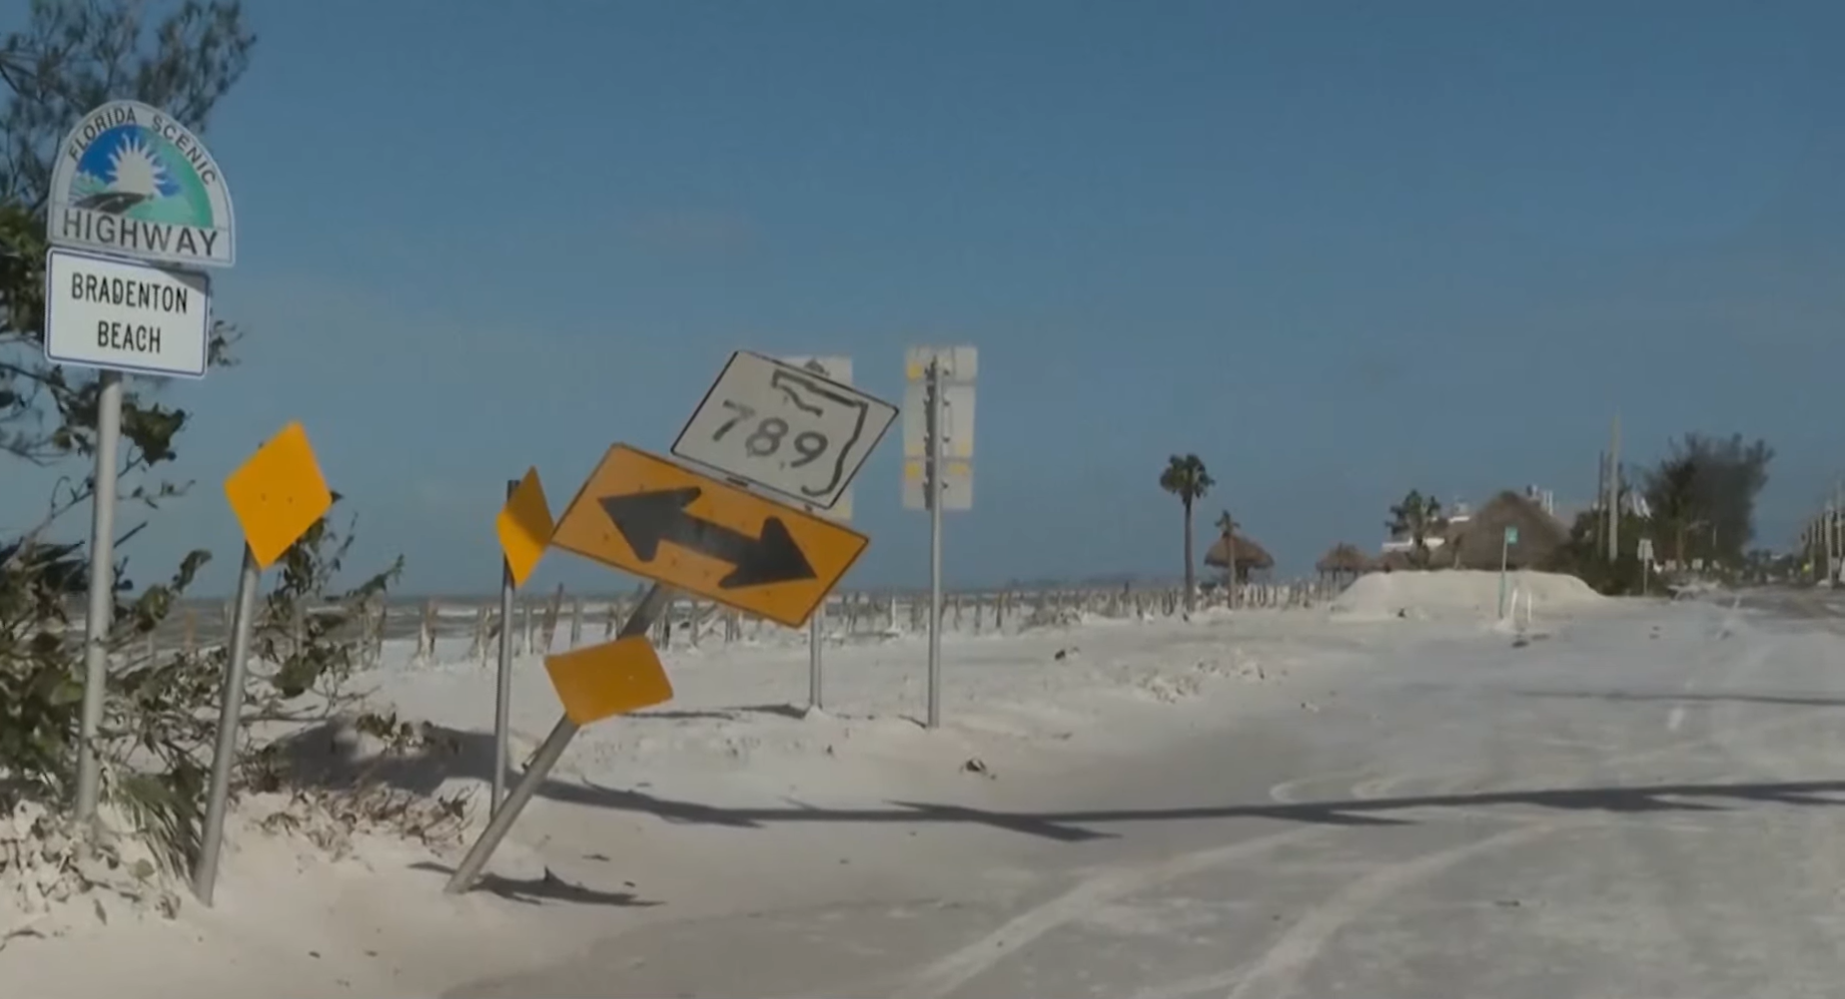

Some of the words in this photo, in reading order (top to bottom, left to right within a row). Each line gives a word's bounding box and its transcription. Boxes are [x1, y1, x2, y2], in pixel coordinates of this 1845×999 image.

[68, 106, 137, 162] FLORIDA
[151, 115, 217, 185] SCENIC
[63, 208, 218, 256] HIGHWAY
[71, 272, 188, 314] BRADENTON
[97, 320, 161, 354] BEACH
[712, 400, 828, 469] 789
